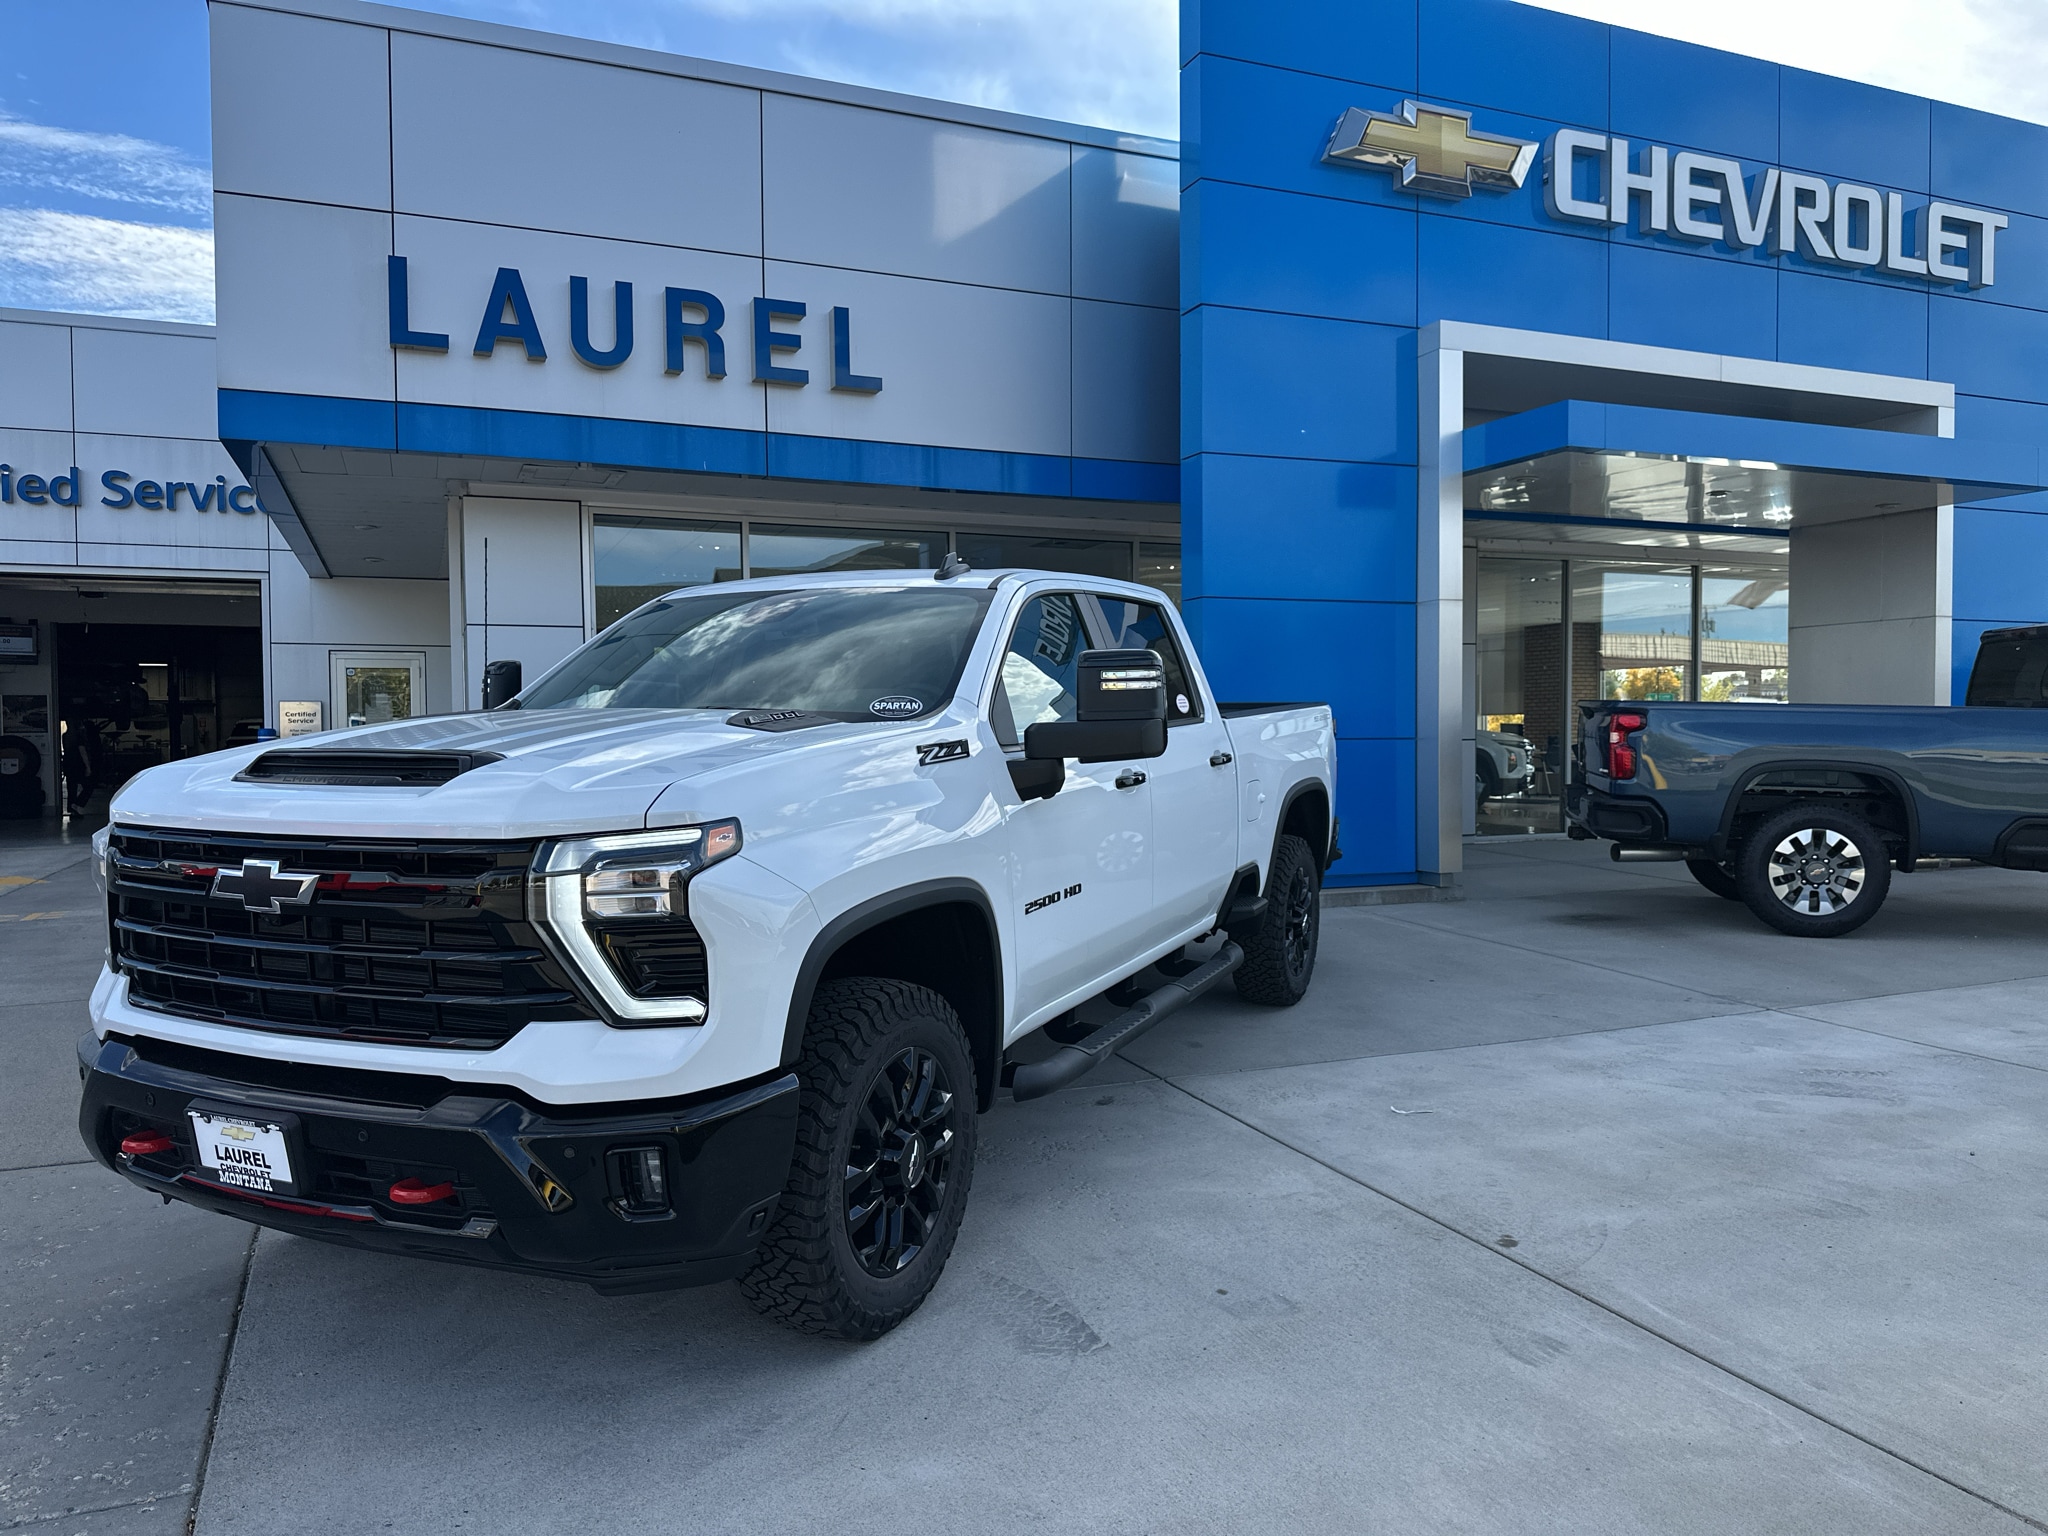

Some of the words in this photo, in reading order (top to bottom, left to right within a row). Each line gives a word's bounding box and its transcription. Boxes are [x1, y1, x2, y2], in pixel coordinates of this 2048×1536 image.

[1545, 127, 2008, 289] CHEVROLET
[388, 254, 883, 395] LAUREL
[873, 702, 919, 710] SPARTAN
[1025, 891, 1061, 915] 2500
[1064, 883, 1082, 899] HD
[215, 1144, 272, 1169] LAUREL
[218, 1171, 274, 1192] MONTANA
[220, 1163, 271, 1179] CHEVROLET
